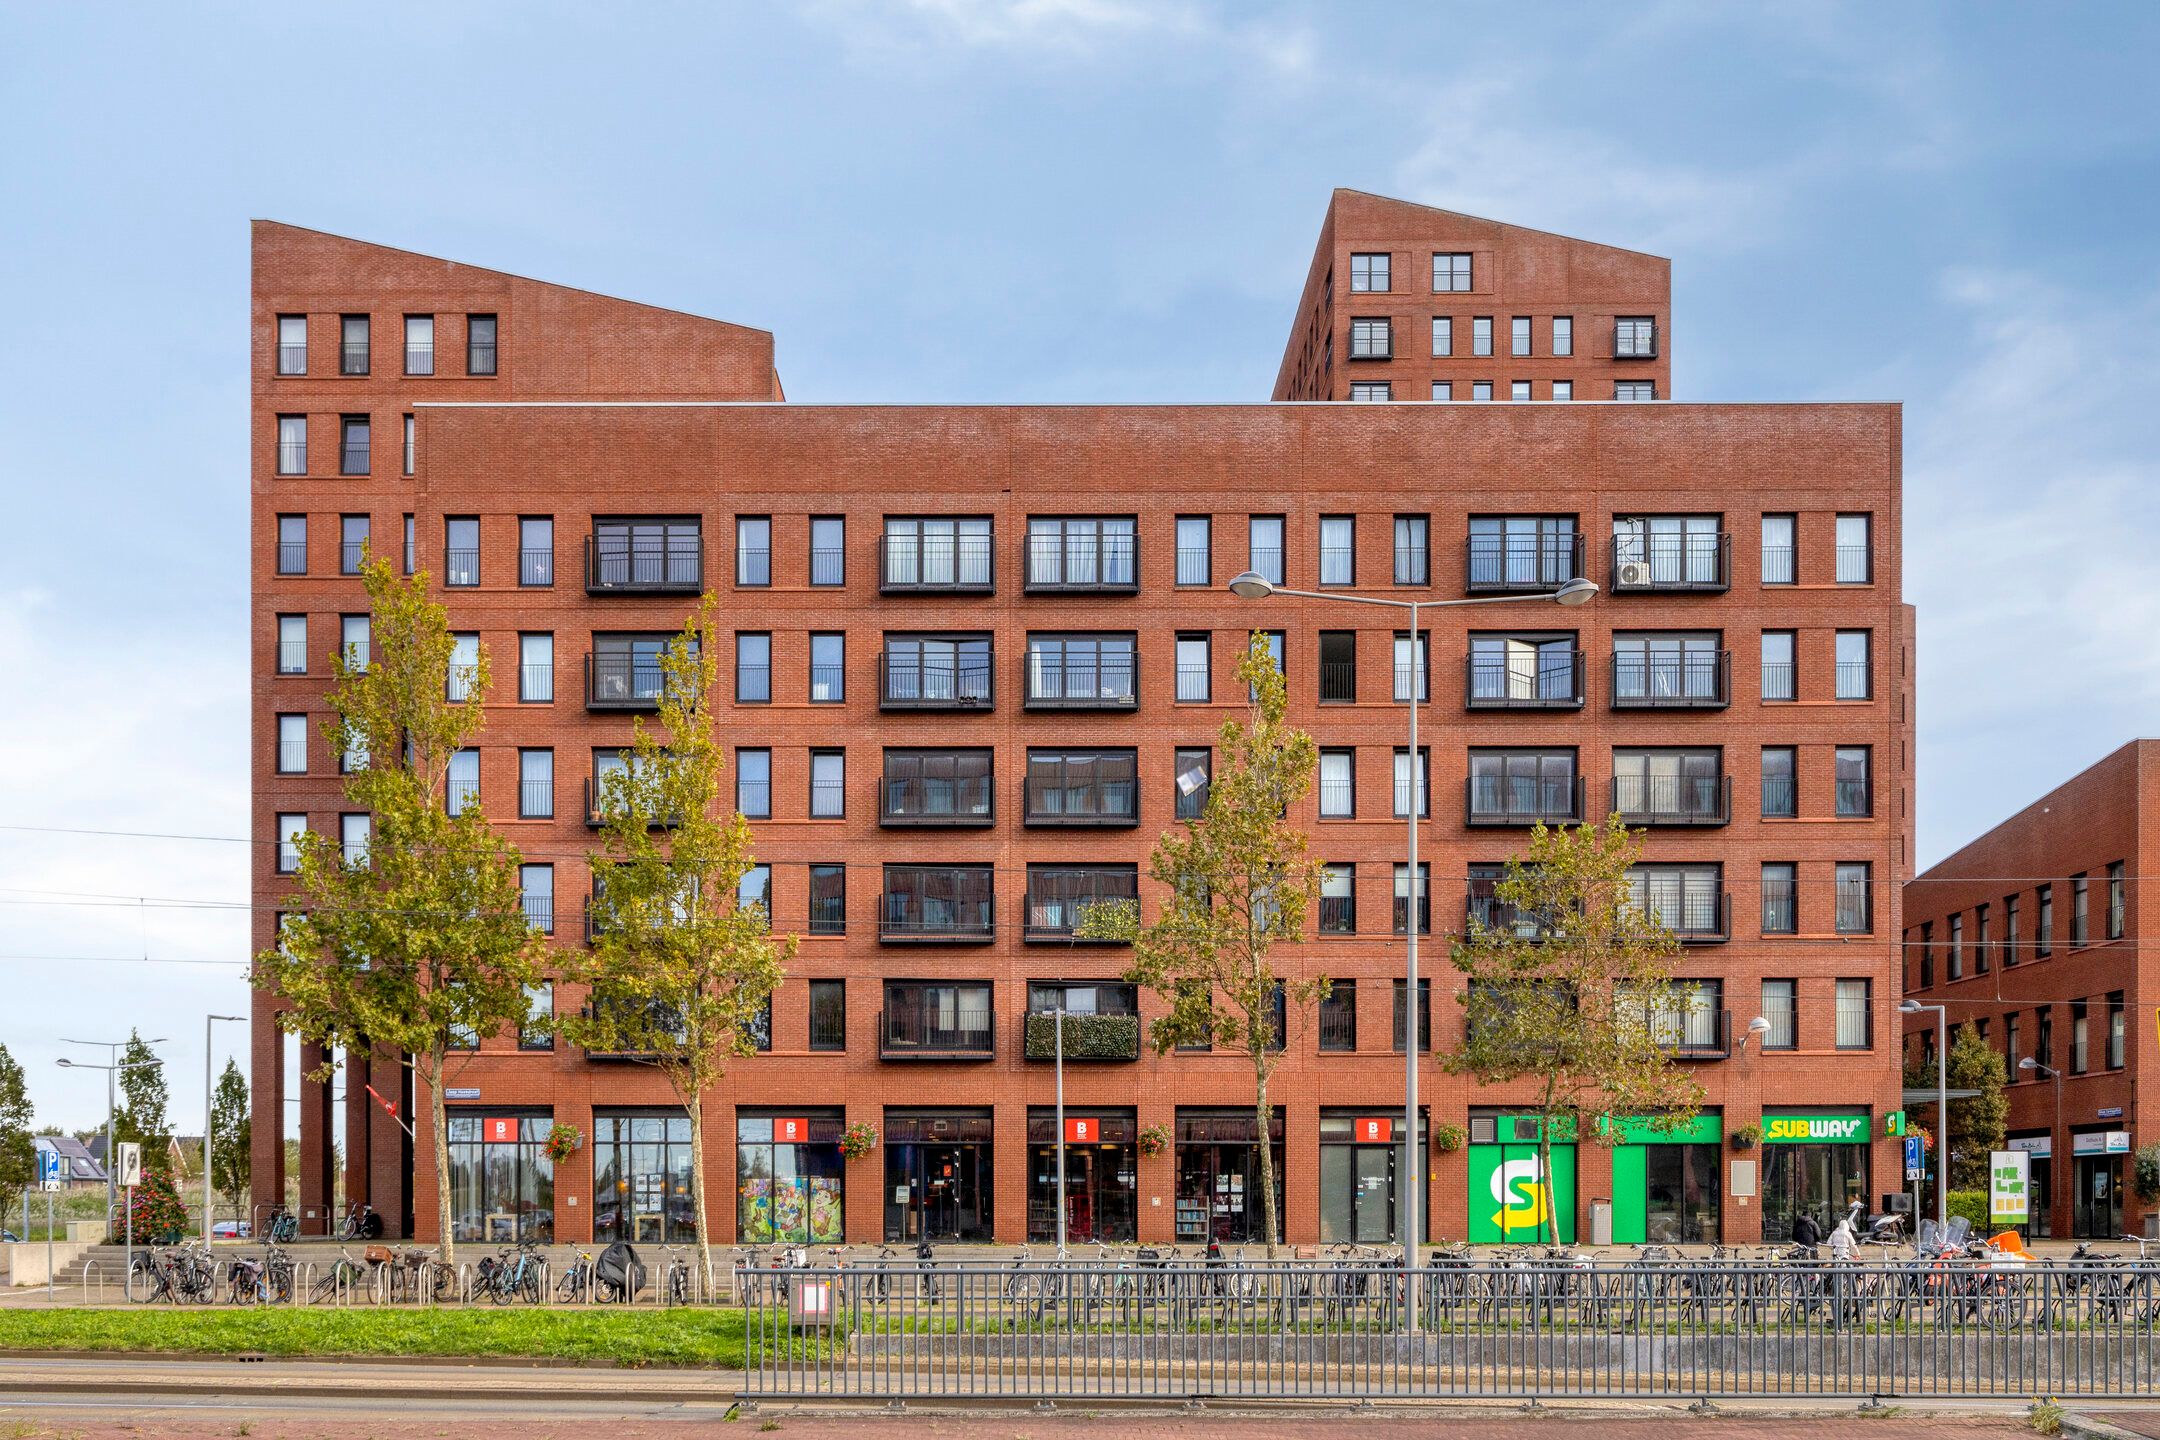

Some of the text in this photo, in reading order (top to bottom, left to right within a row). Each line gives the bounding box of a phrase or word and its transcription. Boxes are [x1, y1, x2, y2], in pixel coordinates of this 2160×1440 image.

[496, 1121, 506, 1133] B
[786, 1122, 796, 1134] B
[1077, 1122, 1087, 1134] B
[1368, 1122, 1378, 1133] B
[1768, 1119, 1861, 1139] SUBWAY
[1908, 1139, 1915, 1156] P
[49, 1152, 57, 1168] P
